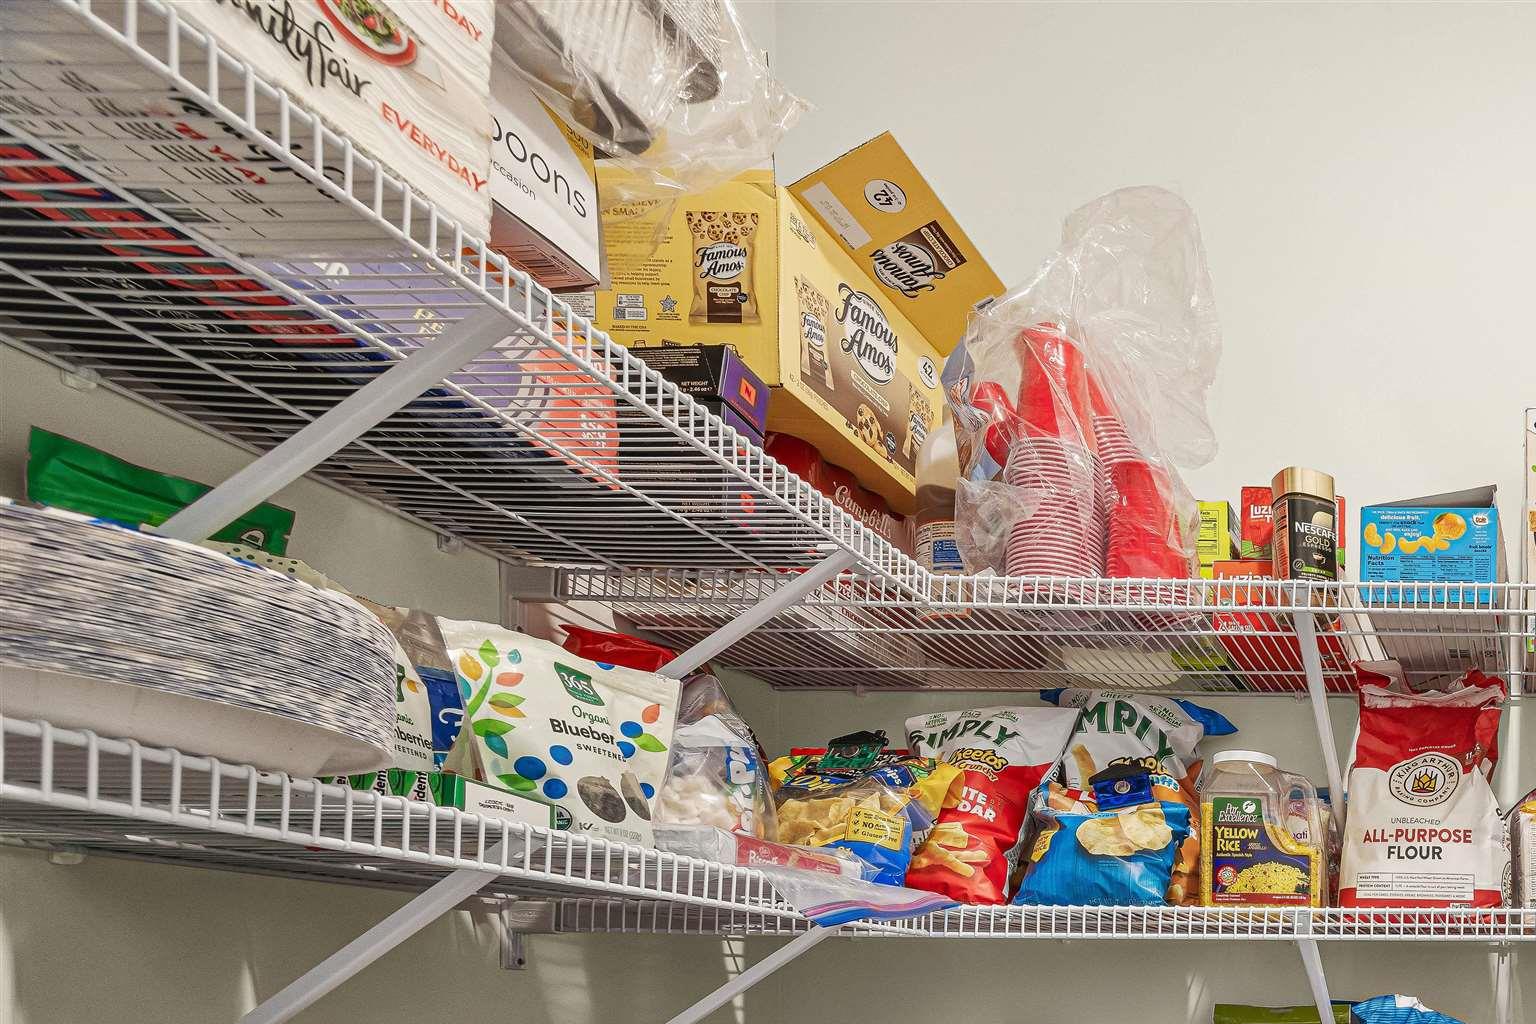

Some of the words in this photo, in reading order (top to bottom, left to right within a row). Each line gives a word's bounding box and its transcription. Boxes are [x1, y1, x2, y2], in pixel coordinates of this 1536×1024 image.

[380, 101, 489, 193] EVERYDAY
[695, 246, 747, 267] Famous
[700, 260, 742, 278] Amos
[835, 283, 899, 353] Famous
[841, 328, 893, 376] Amos
[561, 671, 592, 695] 365
[909, 719, 1027, 747] SIMPLY
[1397, 761, 1420, 779] KING
[1422, 757, 1455, 779] ARTHUR
[1418, 786, 1451, 804] COMPANY
[1218, 810, 1258, 823] Excellence
[1390, 817, 1441, 825] UNBLEACHED
[1215, 827, 1258, 840] YELLOW
[1363, 829, 1472, 844] ALL-PURPOSE
[1216, 839, 1240, 852] RICE
[1387, 846, 1442, 860] FLOUR
